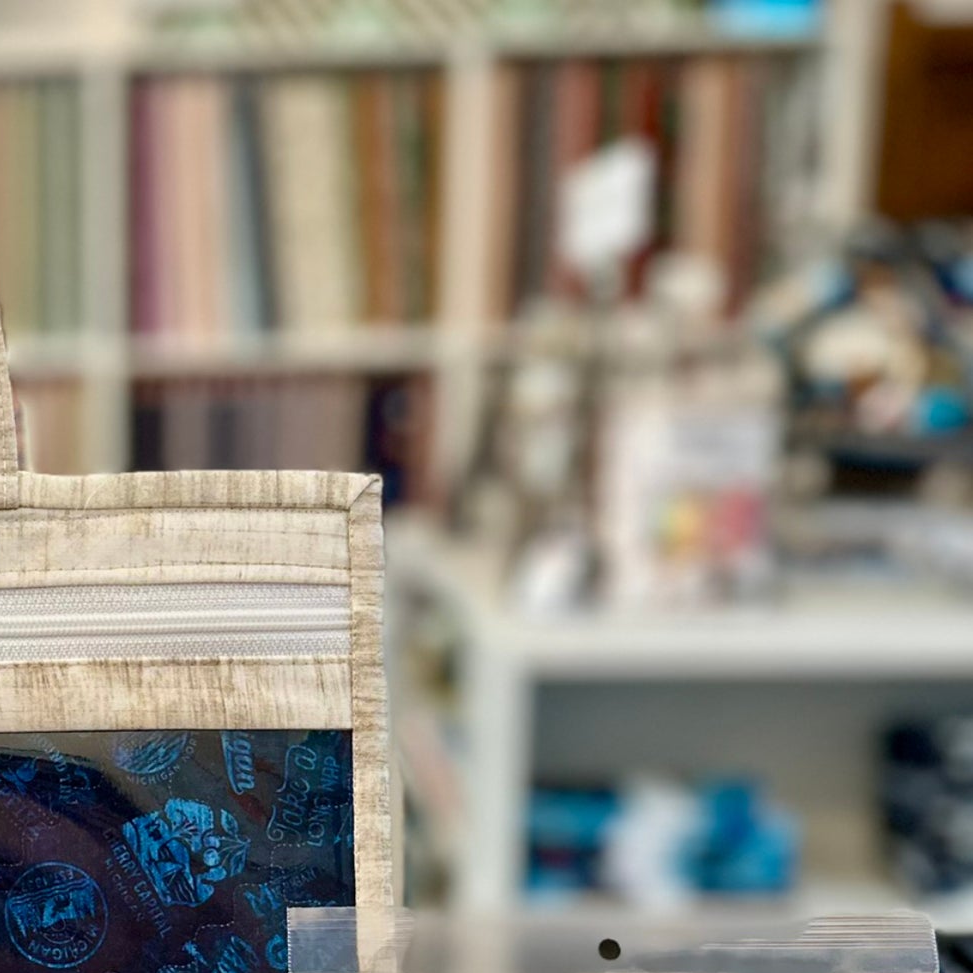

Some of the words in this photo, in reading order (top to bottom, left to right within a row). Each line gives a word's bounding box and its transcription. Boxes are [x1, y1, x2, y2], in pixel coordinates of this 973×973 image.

[267, 776, 312, 842] Take
[307, 796, 329, 848] LONG
[321, 755, 341, 791] NAP
[102, 828, 142, 878] CHERRY
[133, 881, 174, 939] CAPITAL
[27, 924, 101, 962] MICHIGAN
